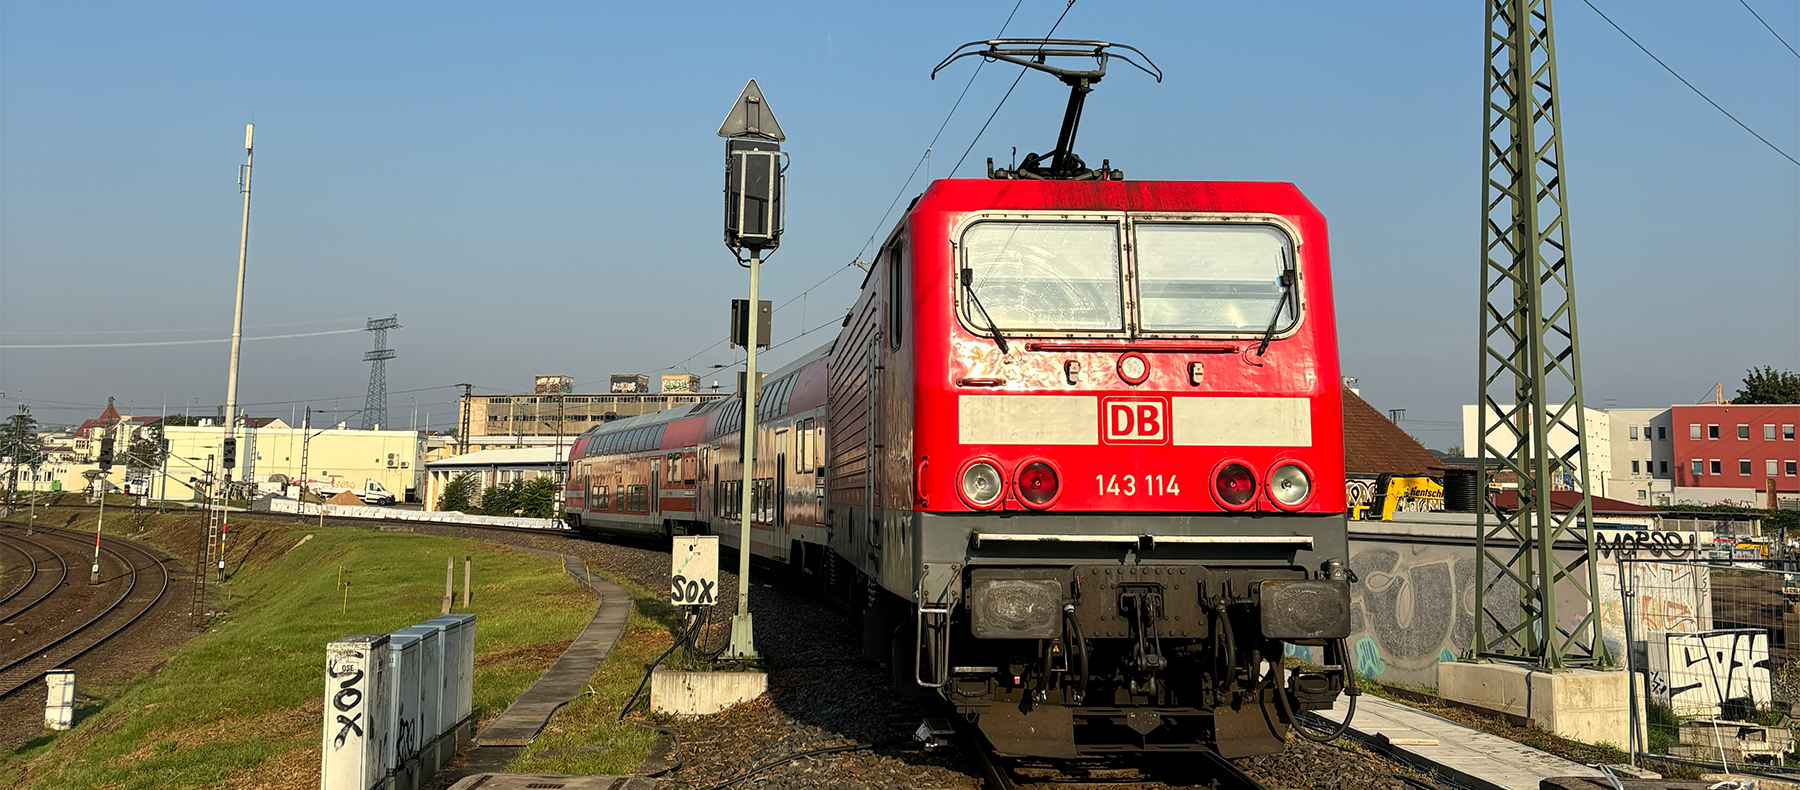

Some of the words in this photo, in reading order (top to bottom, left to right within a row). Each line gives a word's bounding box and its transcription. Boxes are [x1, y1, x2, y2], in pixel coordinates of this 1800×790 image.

[1111, 404, 1161, 436] DB
[1096, 474, 1136, 496] 143
[1145, 474, 1180, 496] 114
